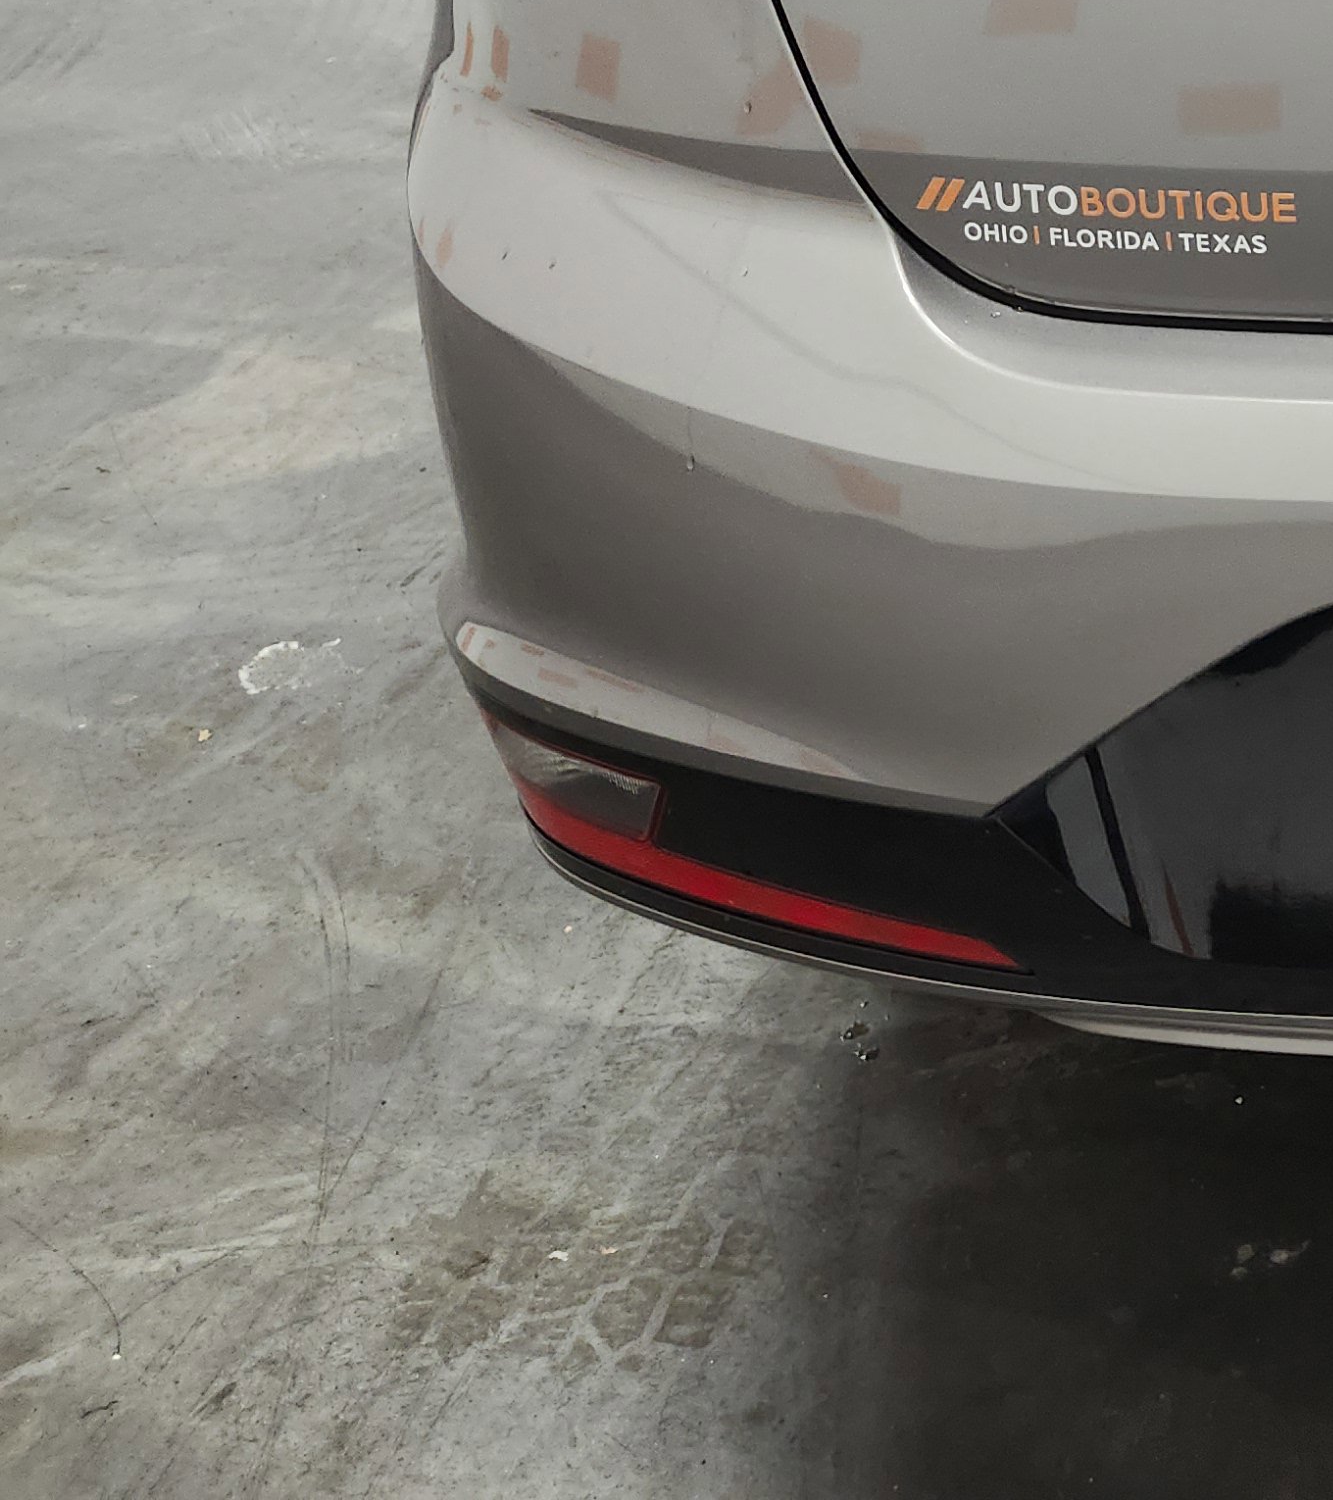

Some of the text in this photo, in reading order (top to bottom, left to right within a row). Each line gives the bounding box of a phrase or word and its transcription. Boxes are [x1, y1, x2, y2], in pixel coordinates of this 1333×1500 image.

[962, 180, 1298, 222] AUTOBOUTIQUE
[964, 222, 1268, 254] OHIO FLORIDA TEXAS
